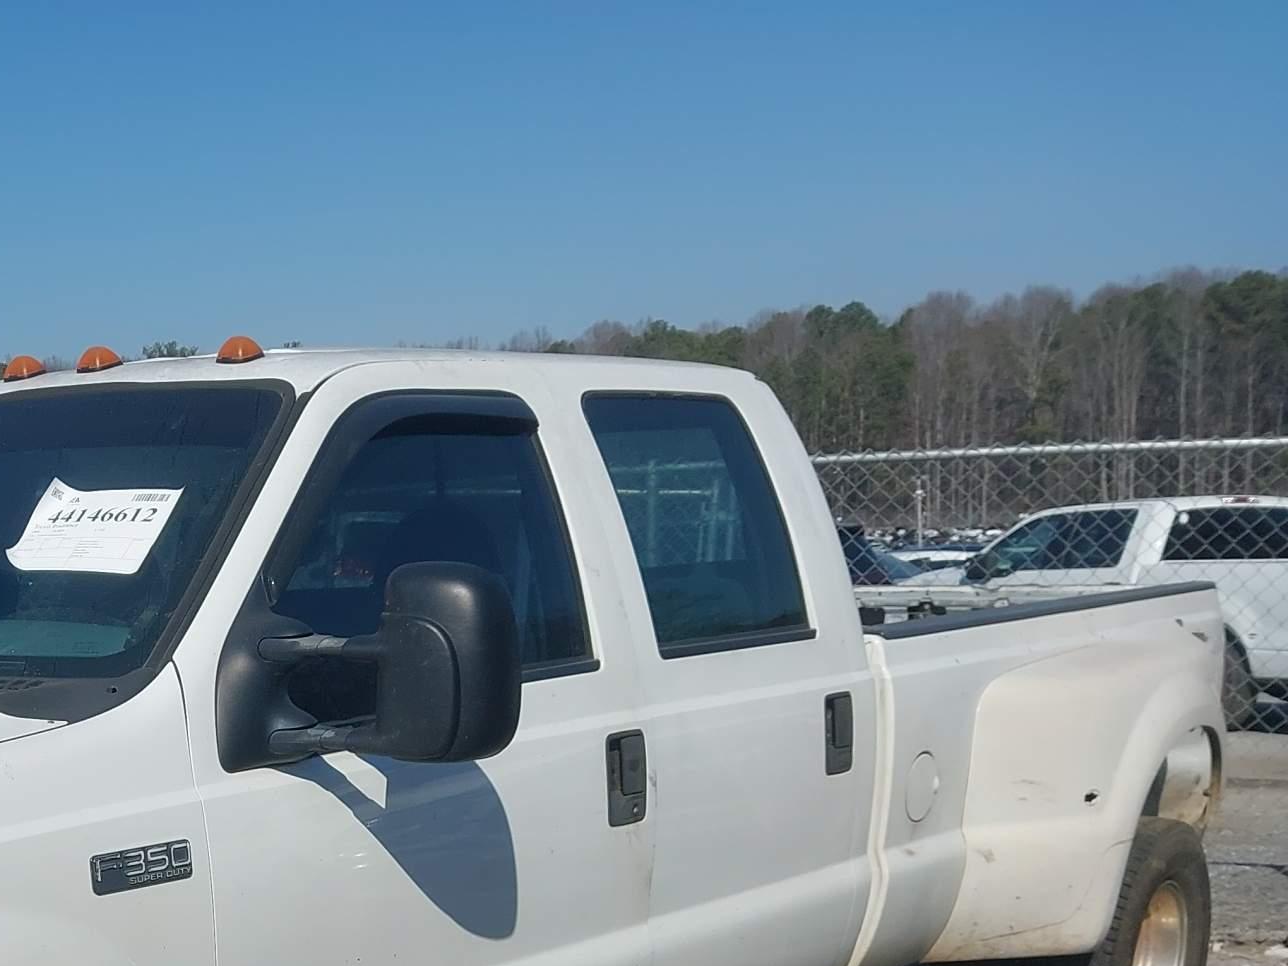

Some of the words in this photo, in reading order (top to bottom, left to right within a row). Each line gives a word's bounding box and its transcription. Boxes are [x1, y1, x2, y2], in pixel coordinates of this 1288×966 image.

[47, 507, 159, 524] 44146612
[128, 872, 163, 885] SUPER
[166, 866, 192, 878] DUTY
